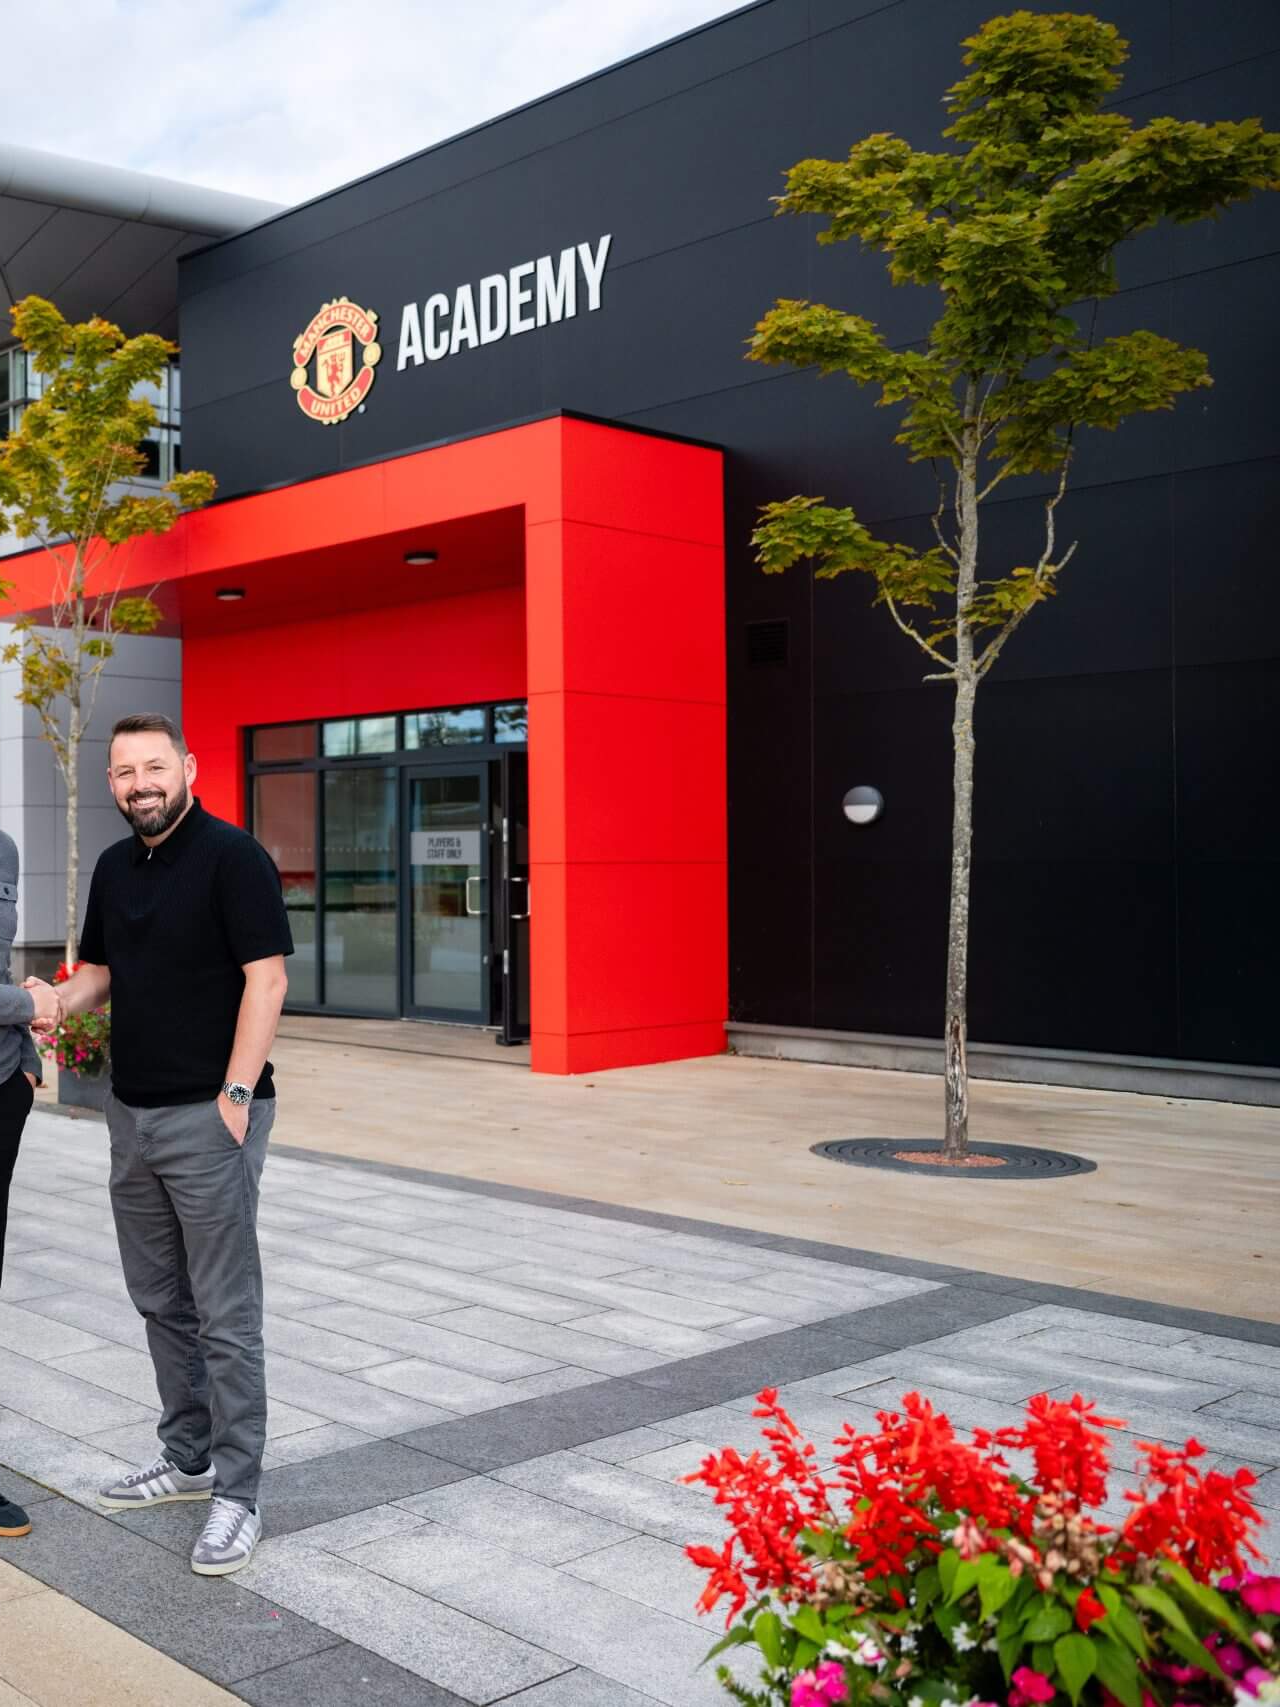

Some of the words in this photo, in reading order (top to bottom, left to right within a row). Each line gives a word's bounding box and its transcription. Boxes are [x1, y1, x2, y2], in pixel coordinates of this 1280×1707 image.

[396, 233, 612, 372] ACADEMY
[300, 307, 371, 355] MANCHESTER
[310, 387, 361, 416] UNITED
